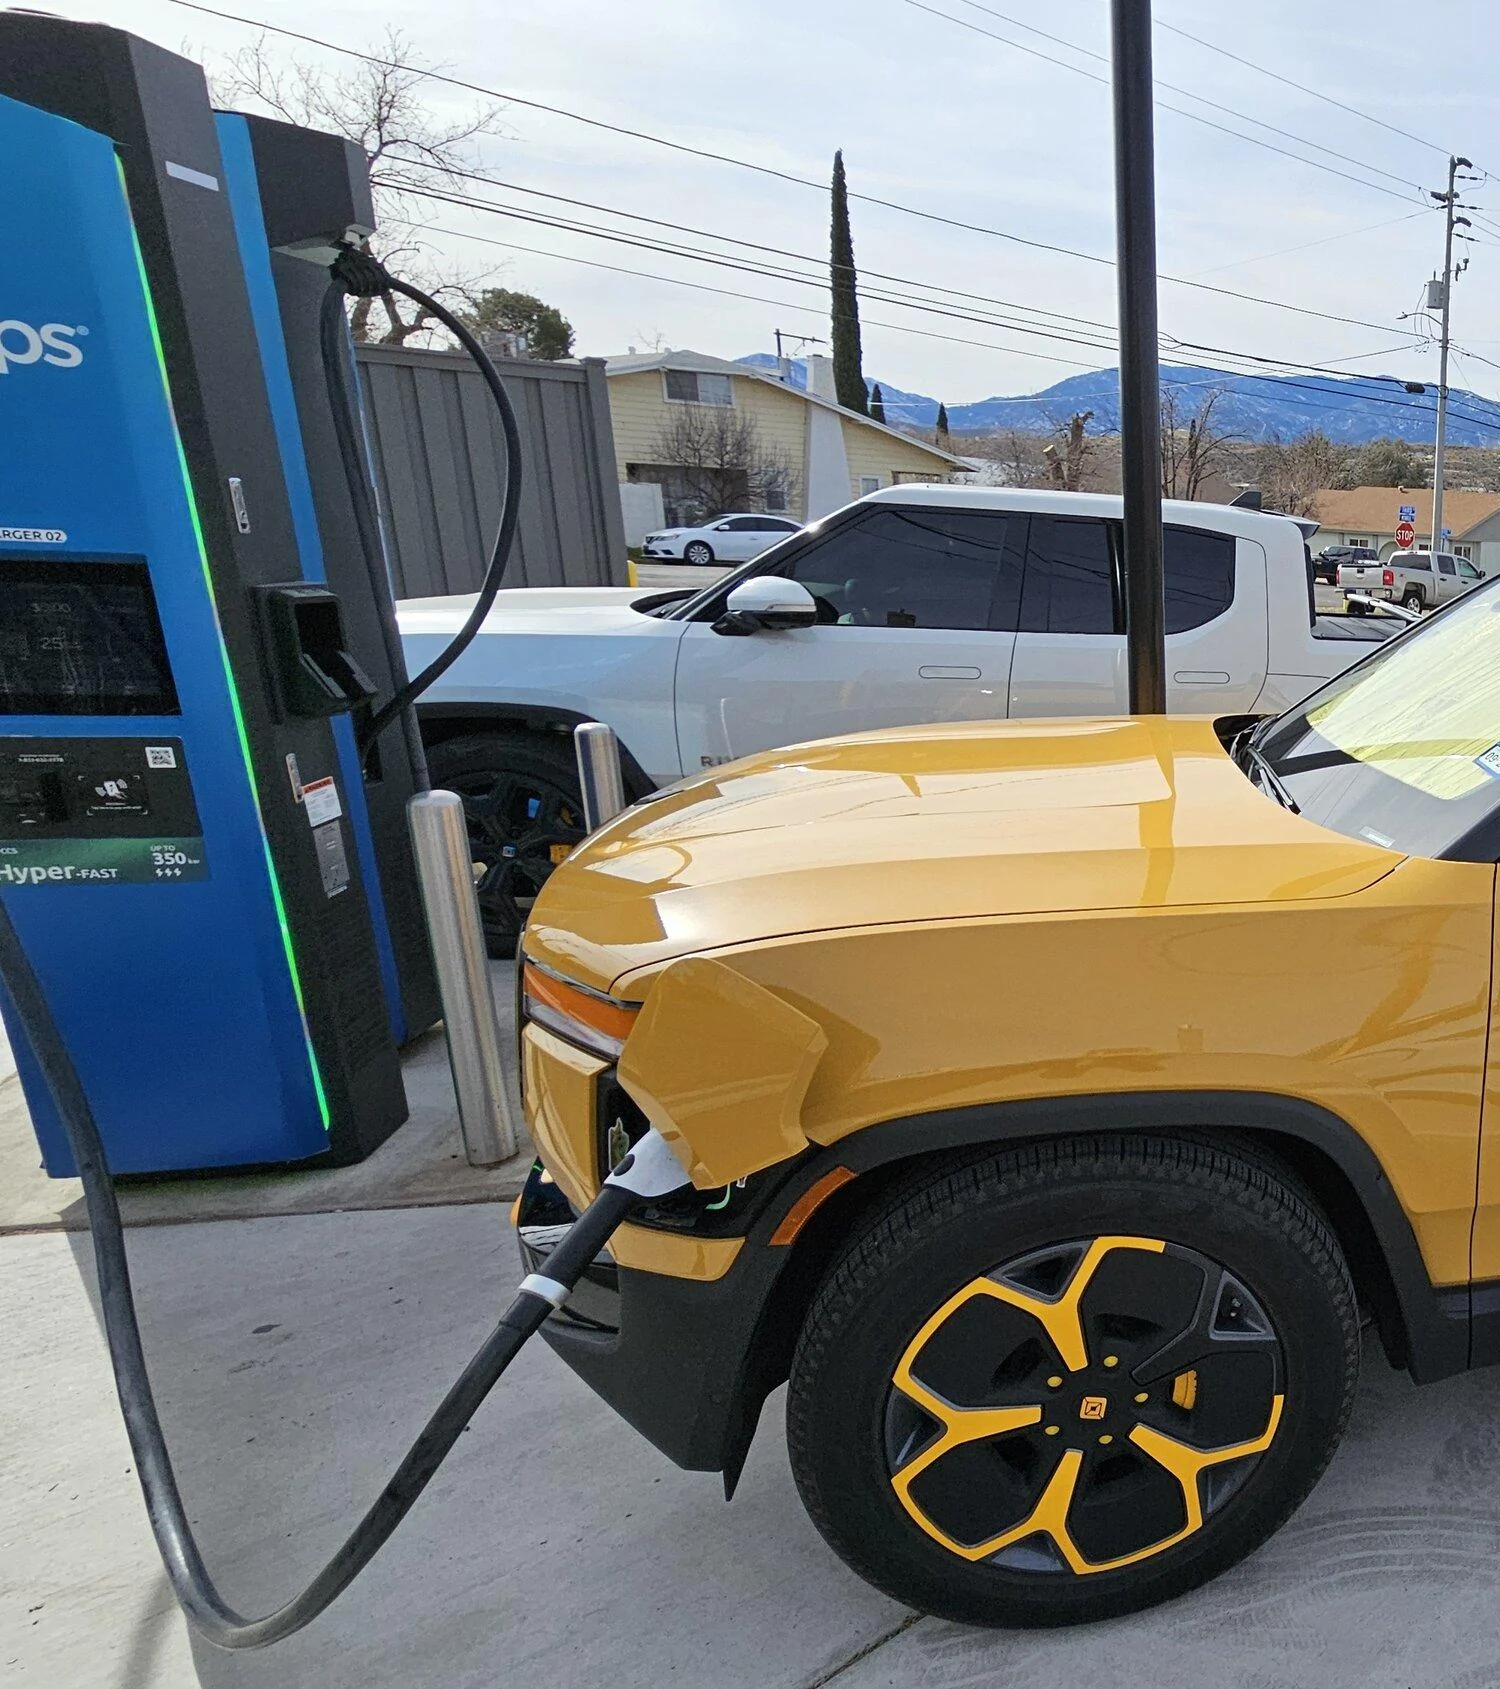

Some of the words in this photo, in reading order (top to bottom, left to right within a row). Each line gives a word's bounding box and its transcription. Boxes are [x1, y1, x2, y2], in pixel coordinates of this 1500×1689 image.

[0, 529, 43, 541] RGER
[45, 531, 63, 542] 02
[1396, 529, 1414, 541] STOP
[152, 852, 187, 865] 350
